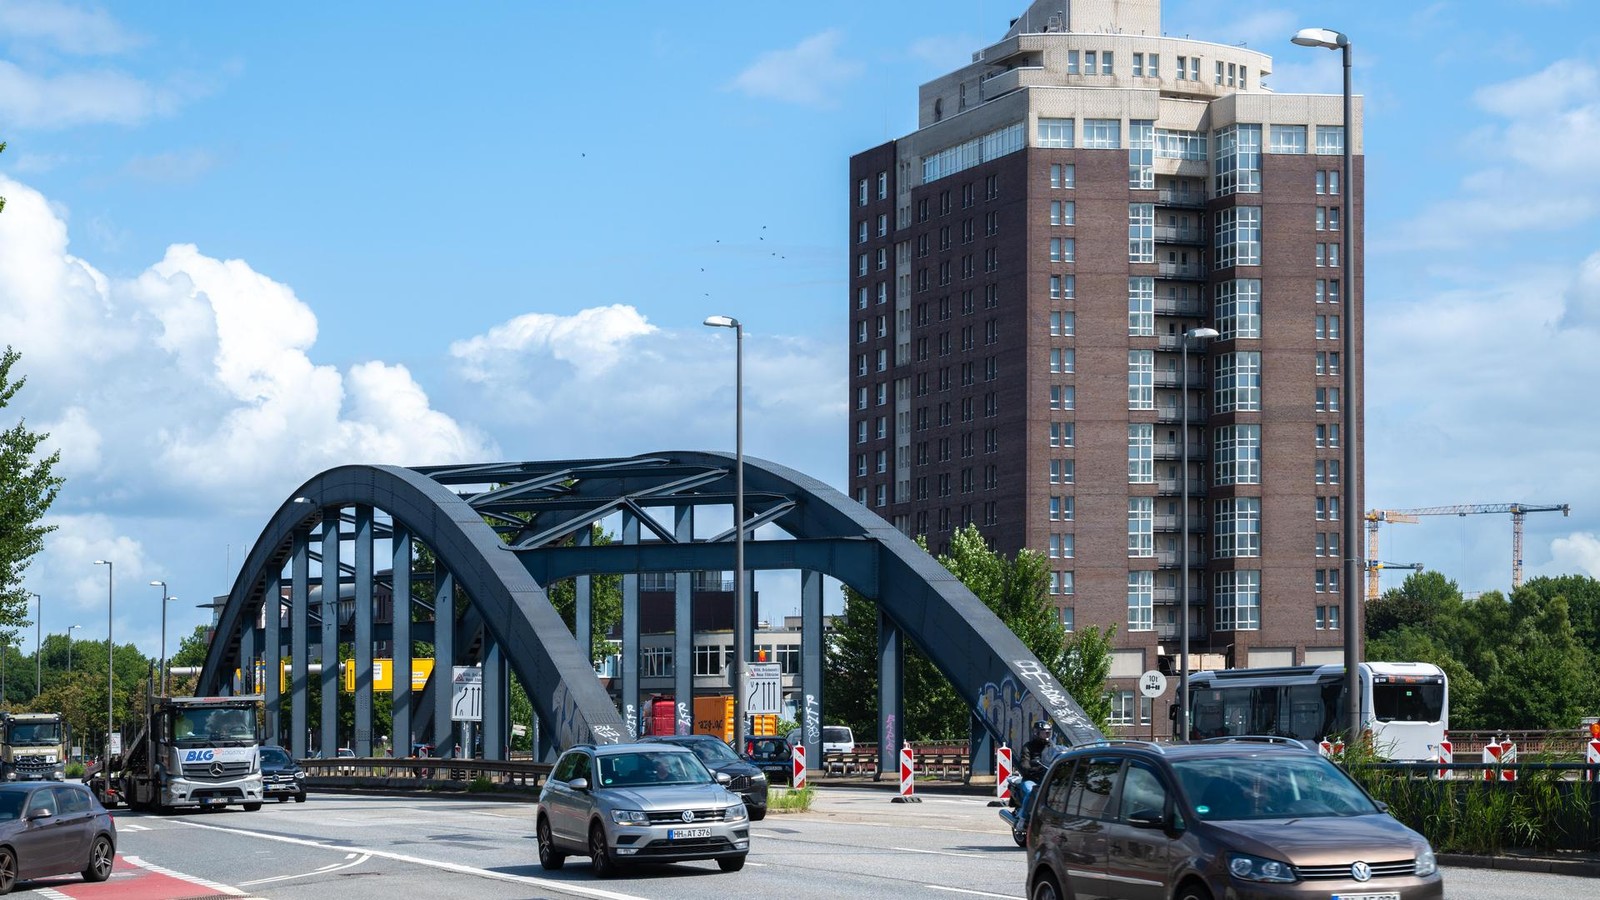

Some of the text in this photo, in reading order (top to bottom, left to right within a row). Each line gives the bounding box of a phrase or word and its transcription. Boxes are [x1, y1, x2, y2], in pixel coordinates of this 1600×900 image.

[1149, 675, 1158, 683] 10t
[185, 750, 214, 762] BLG
[673, 829, 711, 838] HH AT 376
